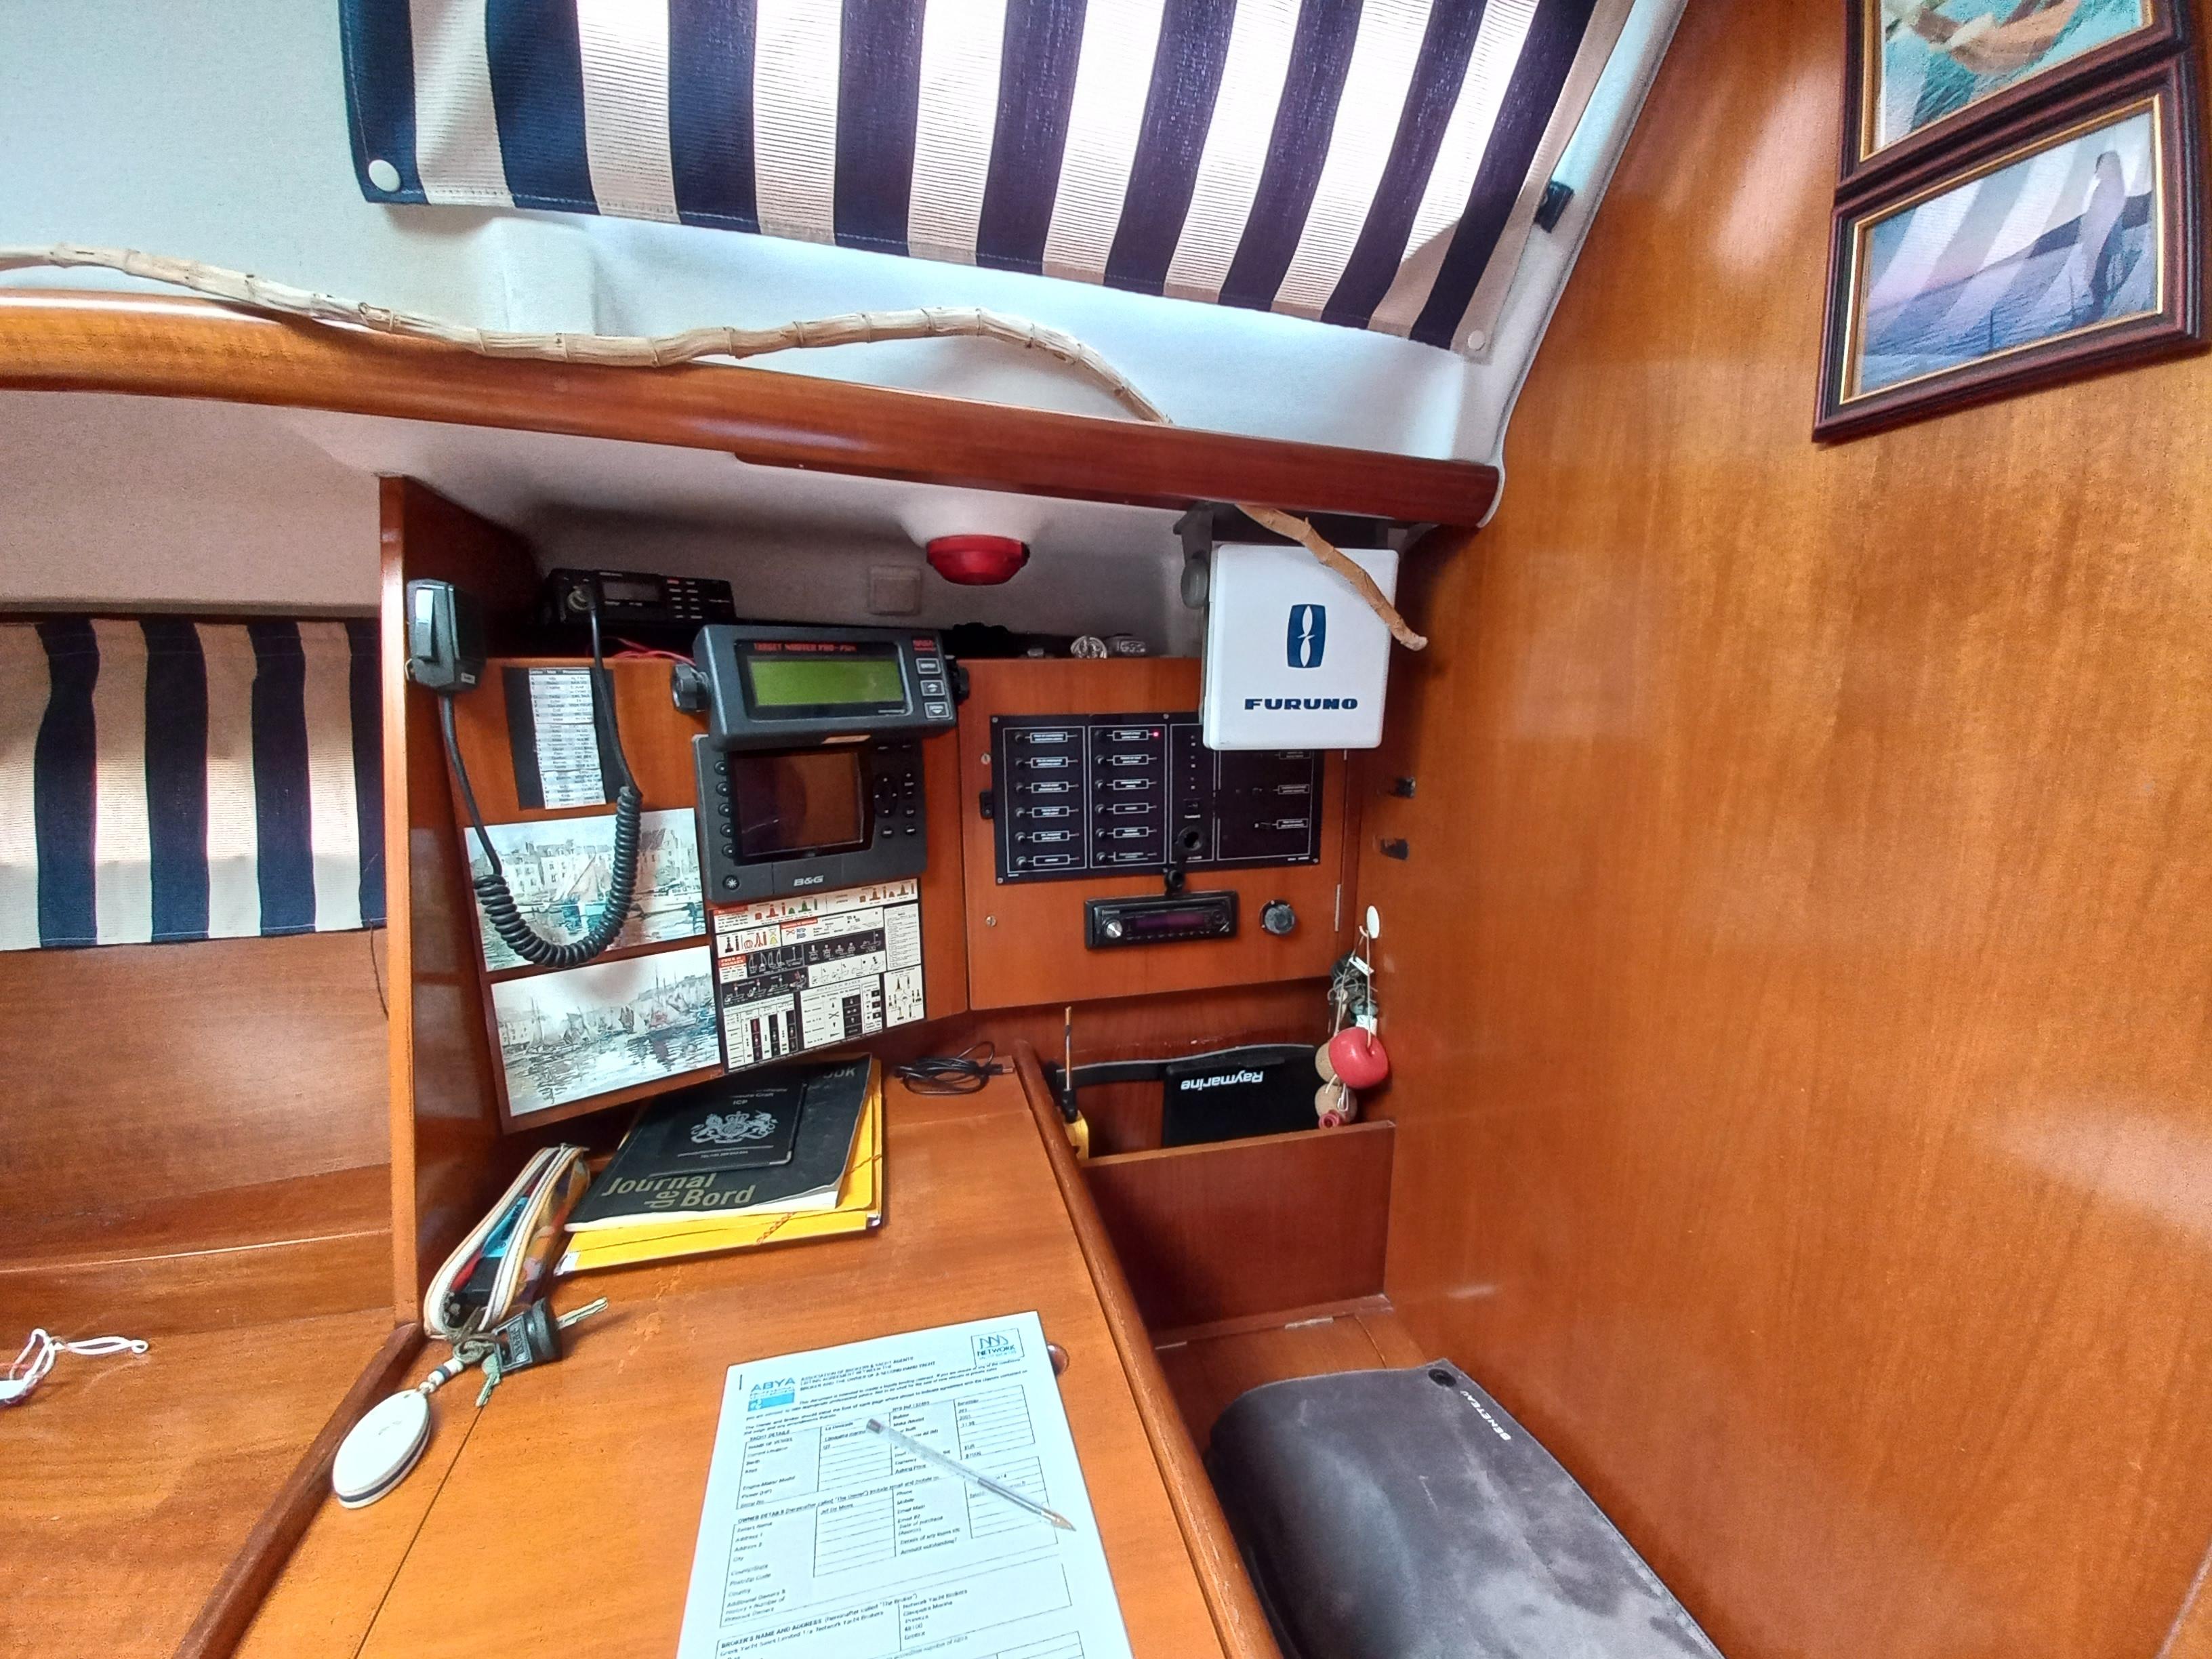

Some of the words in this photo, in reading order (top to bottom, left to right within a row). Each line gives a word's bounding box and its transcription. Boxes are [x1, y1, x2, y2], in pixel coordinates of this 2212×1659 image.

[1244, 698, 1358, 710] FURUNO
[793, 875, 824, 887] B&G
[1181, 1069, 1264, 1091] Raymarine
[602, 1172, 716, 1197] Journal
[644, 1190, 678, 1209] de
[680, 1185, 757, 1208] Bord
[977, 1344, 1015, 1356] NETWORK
[751, 1376, 796, 1392] ABYA
[1460, 1390, 1511, 1441] BENETEAU
